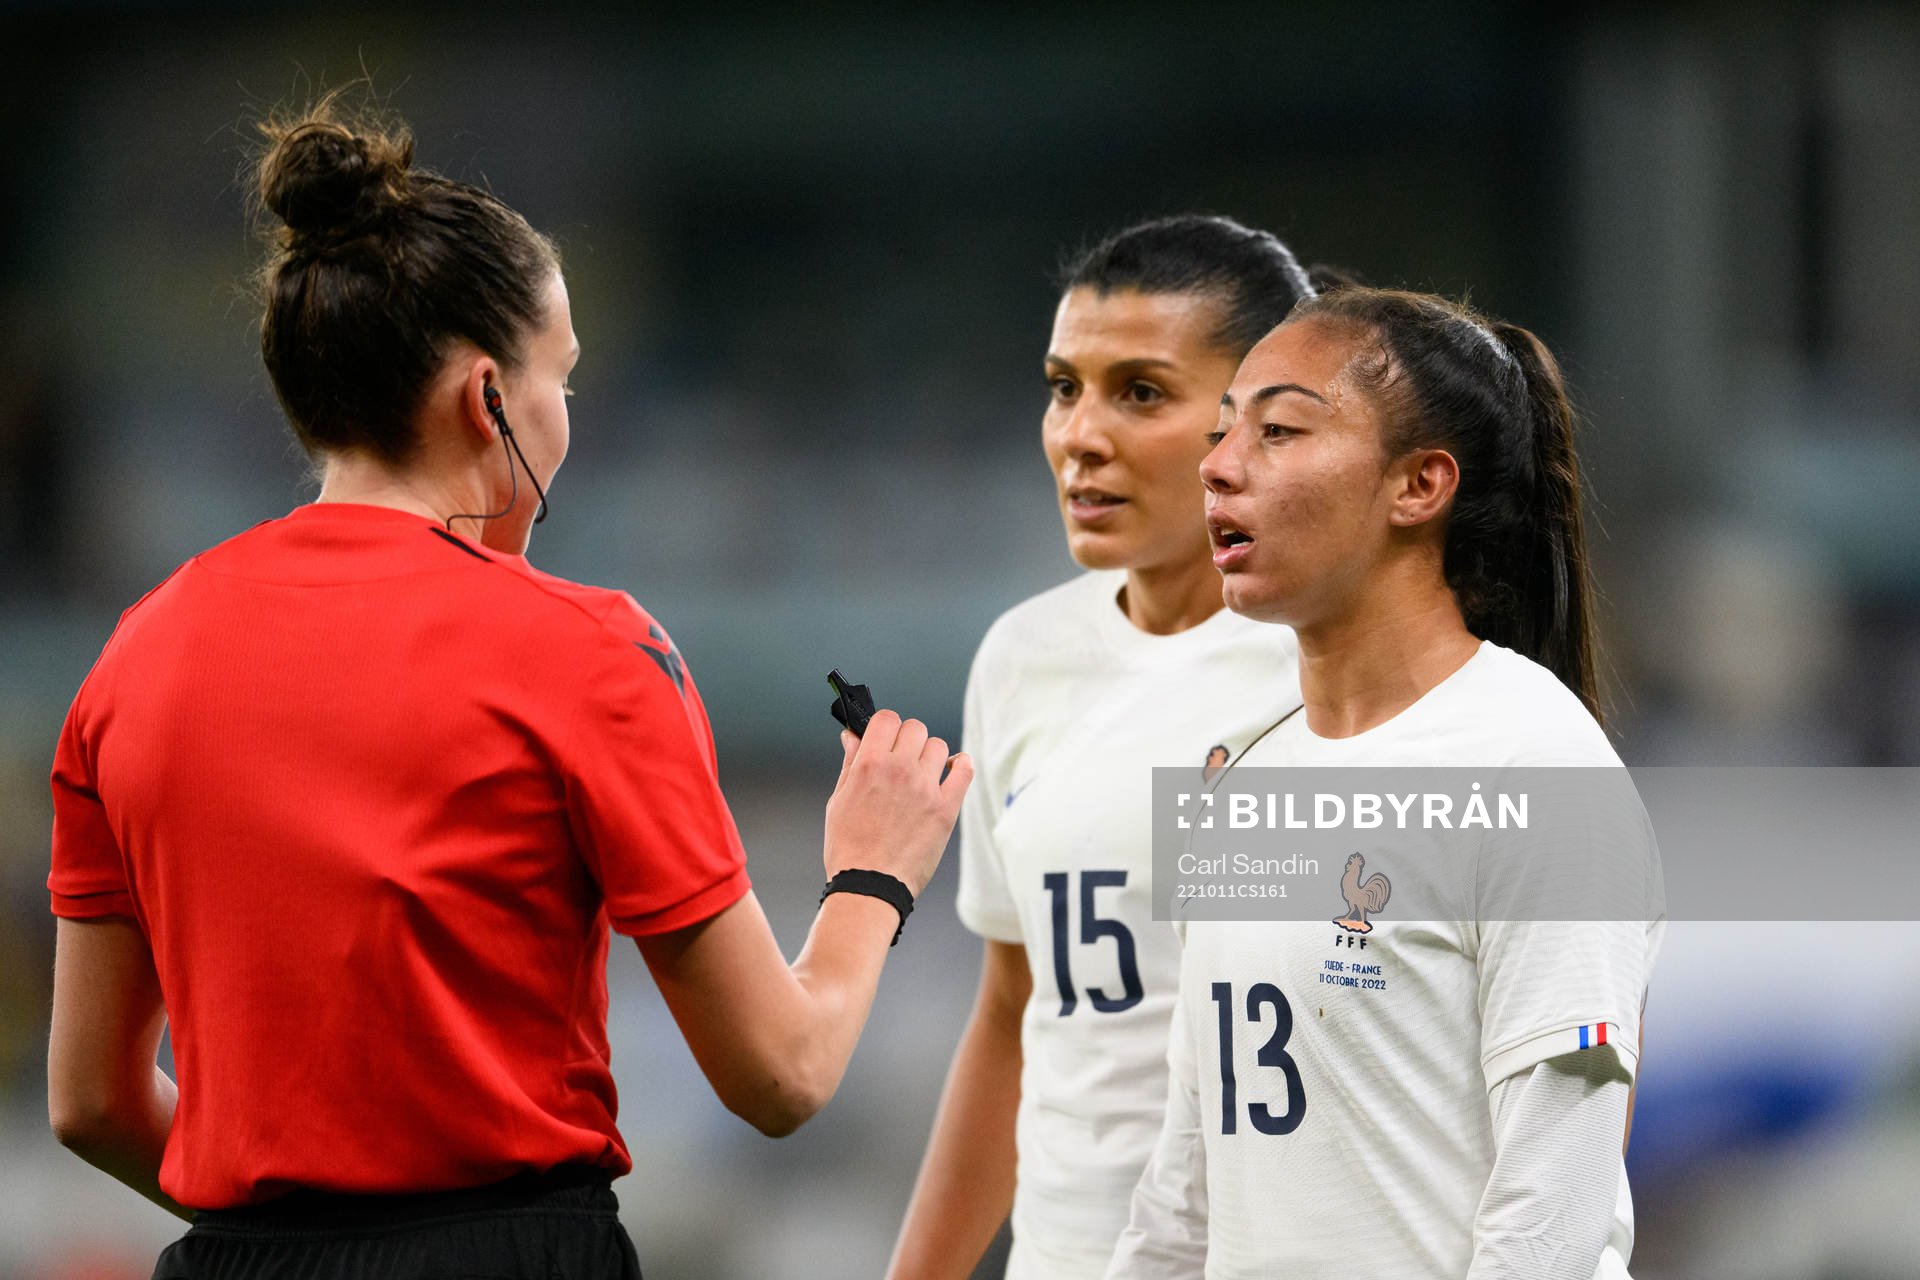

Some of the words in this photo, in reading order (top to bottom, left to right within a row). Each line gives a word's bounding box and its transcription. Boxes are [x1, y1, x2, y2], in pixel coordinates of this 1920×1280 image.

[1043, 870, 1144, 1017] 15
[1324, 960, 1344, 972] SUEDE
[1352, 964, 1382, 975] FRANCE
[1326, 974, 1359, 987] OCTOBRE
[1361, 979, 1386, 990] 2022
[1211, 982, 1307, 1136] 13
